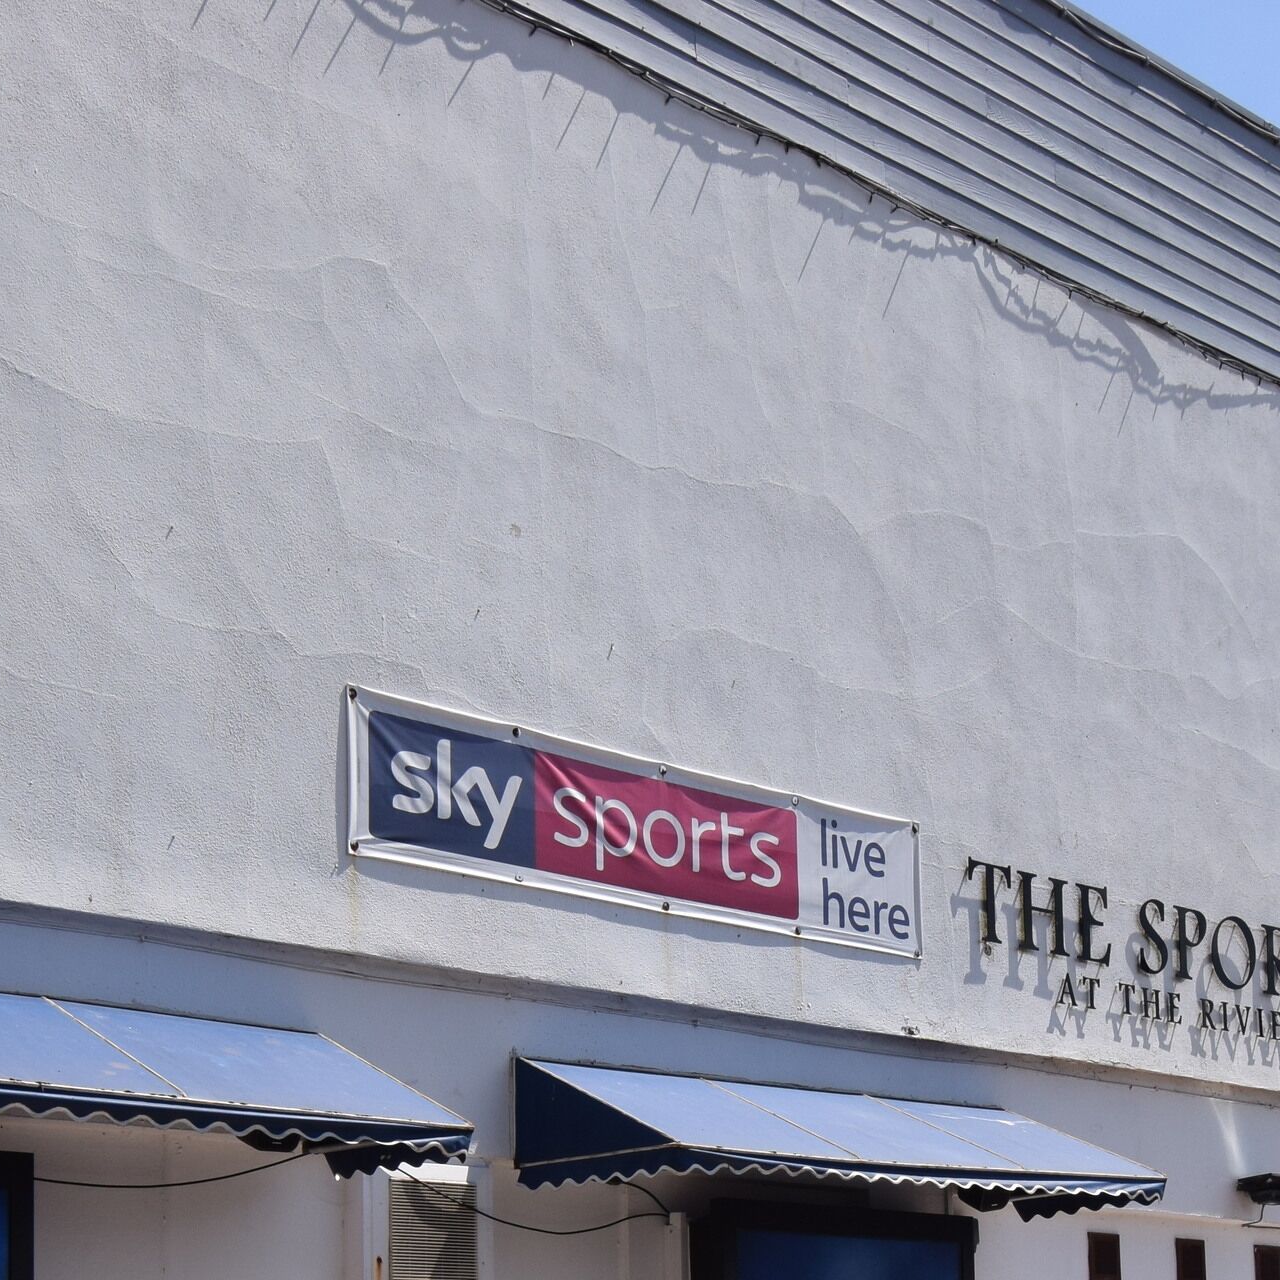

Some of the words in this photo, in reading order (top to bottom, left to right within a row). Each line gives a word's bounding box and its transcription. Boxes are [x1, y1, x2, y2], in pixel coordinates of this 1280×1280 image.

[391, 739, 522, 849] sky
[552, 787, 782, 888] sports
[821, 818, 886, 878] live
[821, 877, 910, 940] here
[967, 856, 1111, 967] THE
[1057, 972, 1101, 1010] AT
[1118, 982, 1183, 1024] THE
